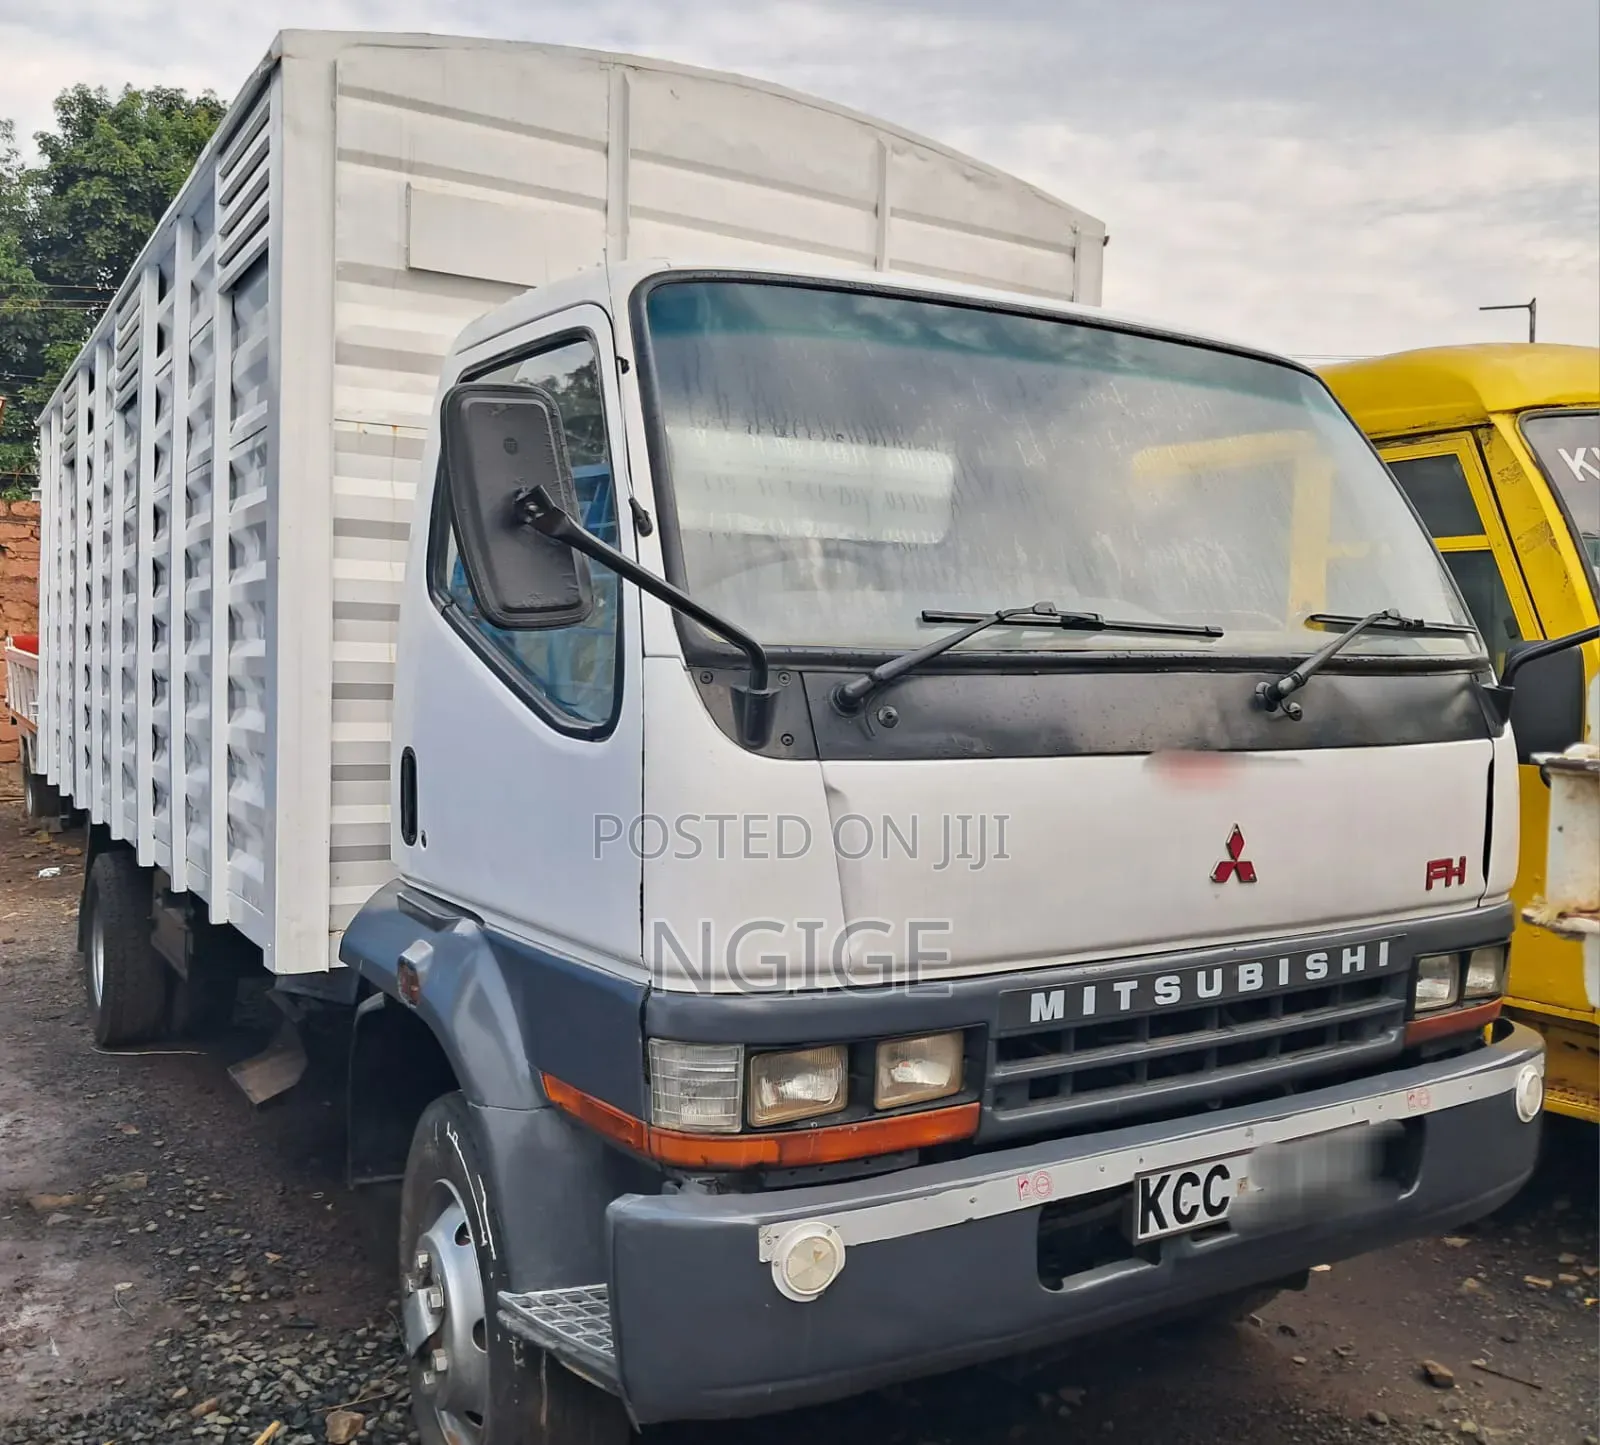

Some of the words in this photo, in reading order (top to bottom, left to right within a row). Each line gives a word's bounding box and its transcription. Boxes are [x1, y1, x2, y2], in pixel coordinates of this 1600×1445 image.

[1557, 448, 1600, 481] K
[1426, 856, 1467, 891] FH
[1030, 941, 1390, 1022] MITSUBISHI
[1139, 1163, 1231, 1235] KCC
